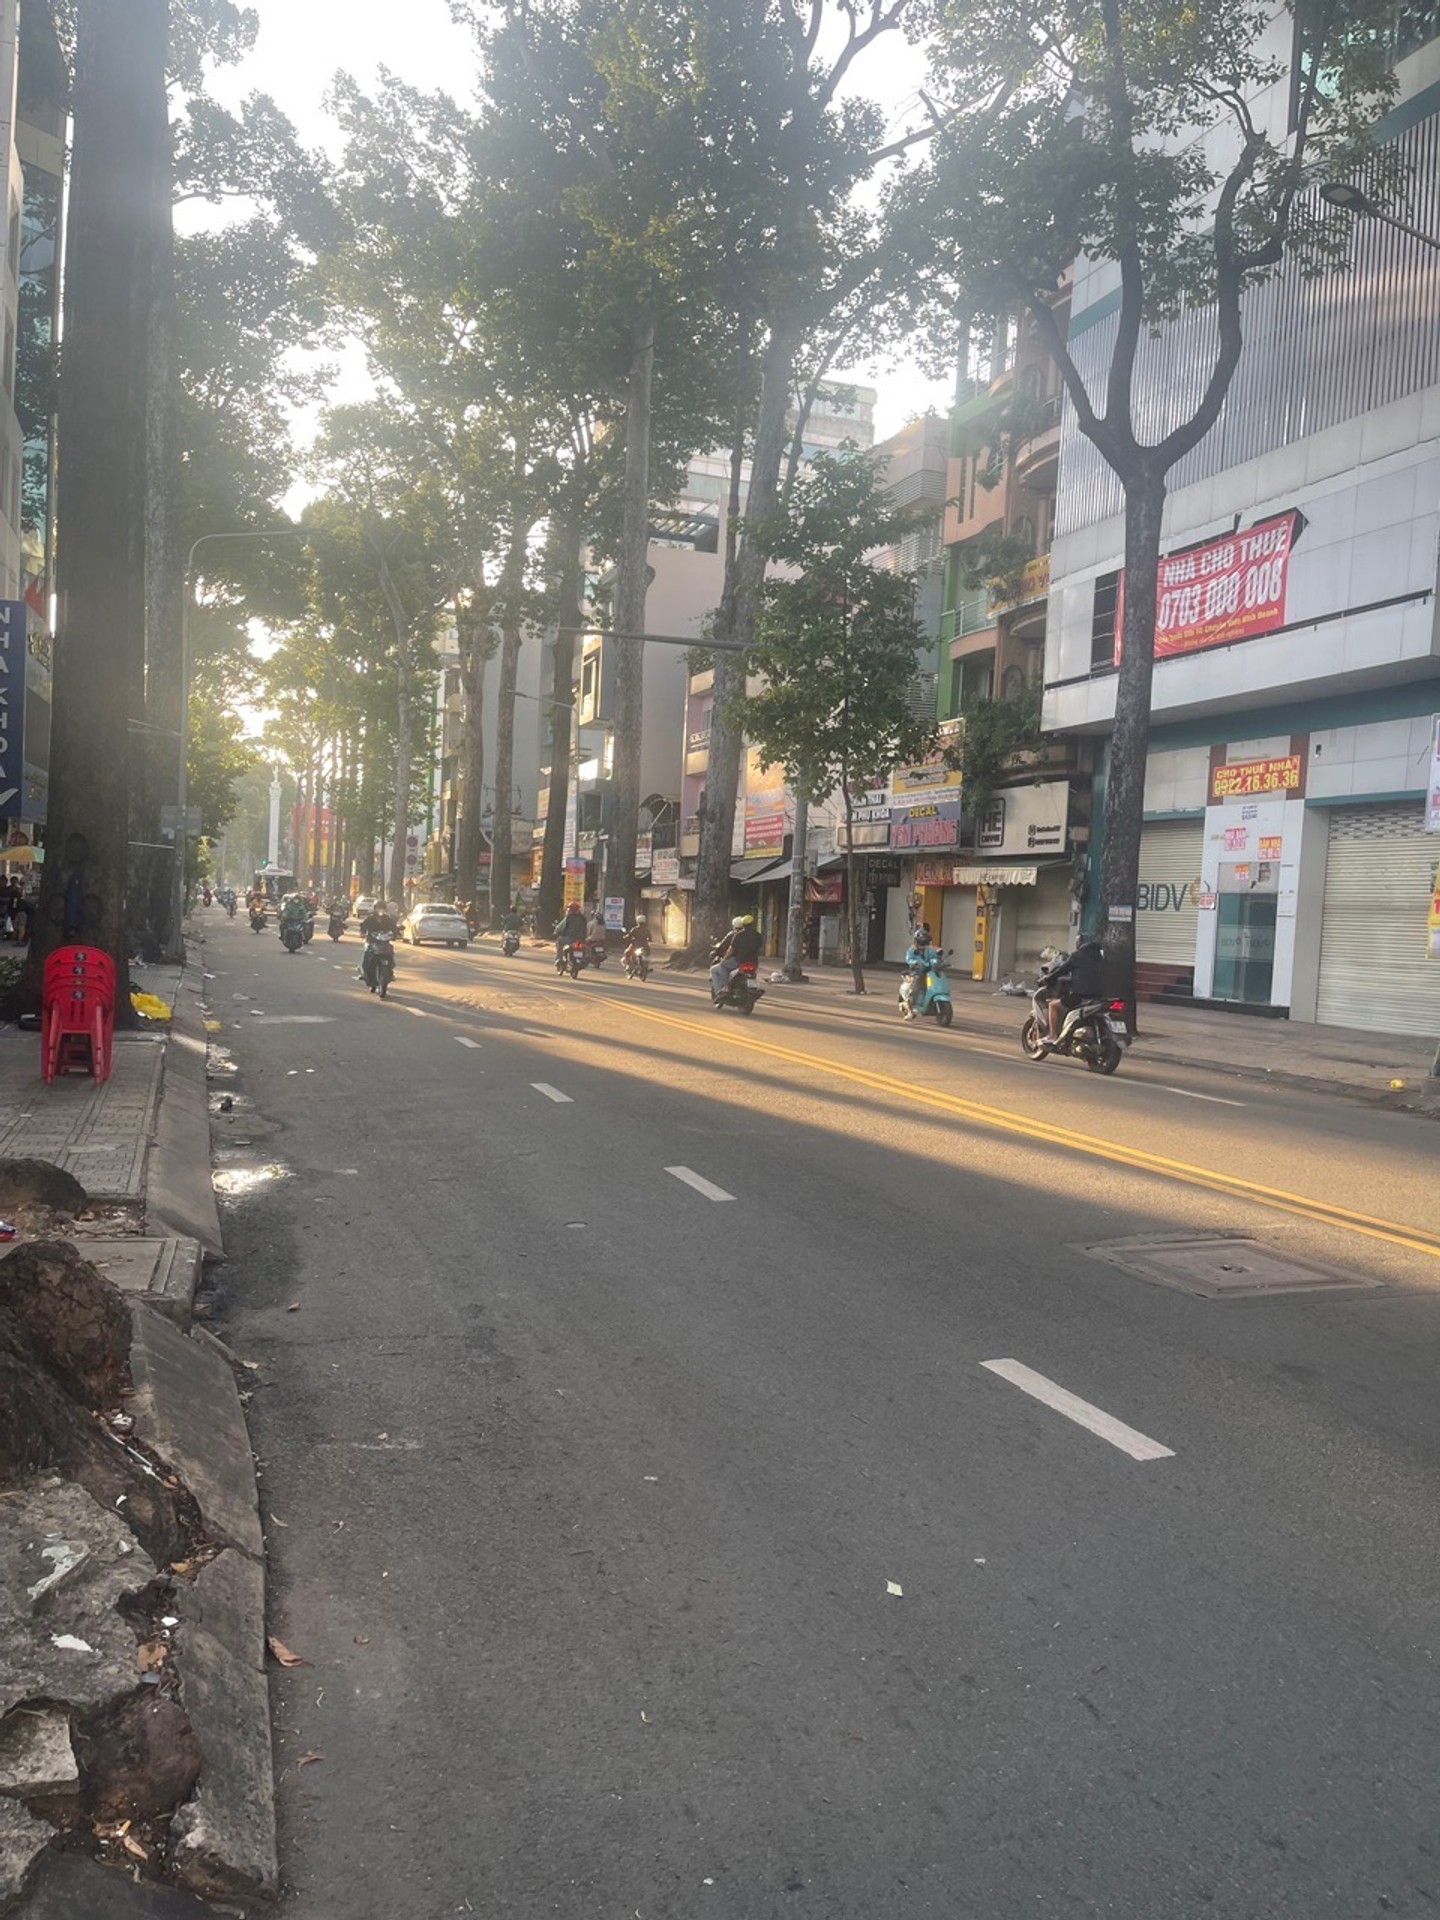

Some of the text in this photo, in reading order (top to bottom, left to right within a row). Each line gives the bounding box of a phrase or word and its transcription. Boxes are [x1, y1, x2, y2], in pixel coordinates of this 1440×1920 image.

[1200, 542, 1235, 575] CHO
[1240, 520, 1288, 563] THUÊ
[1216, 767, 1238, 780] CHO
[908, 805, 939, 818] DECAL
[1137, 883, 1188, 911] BIDV
